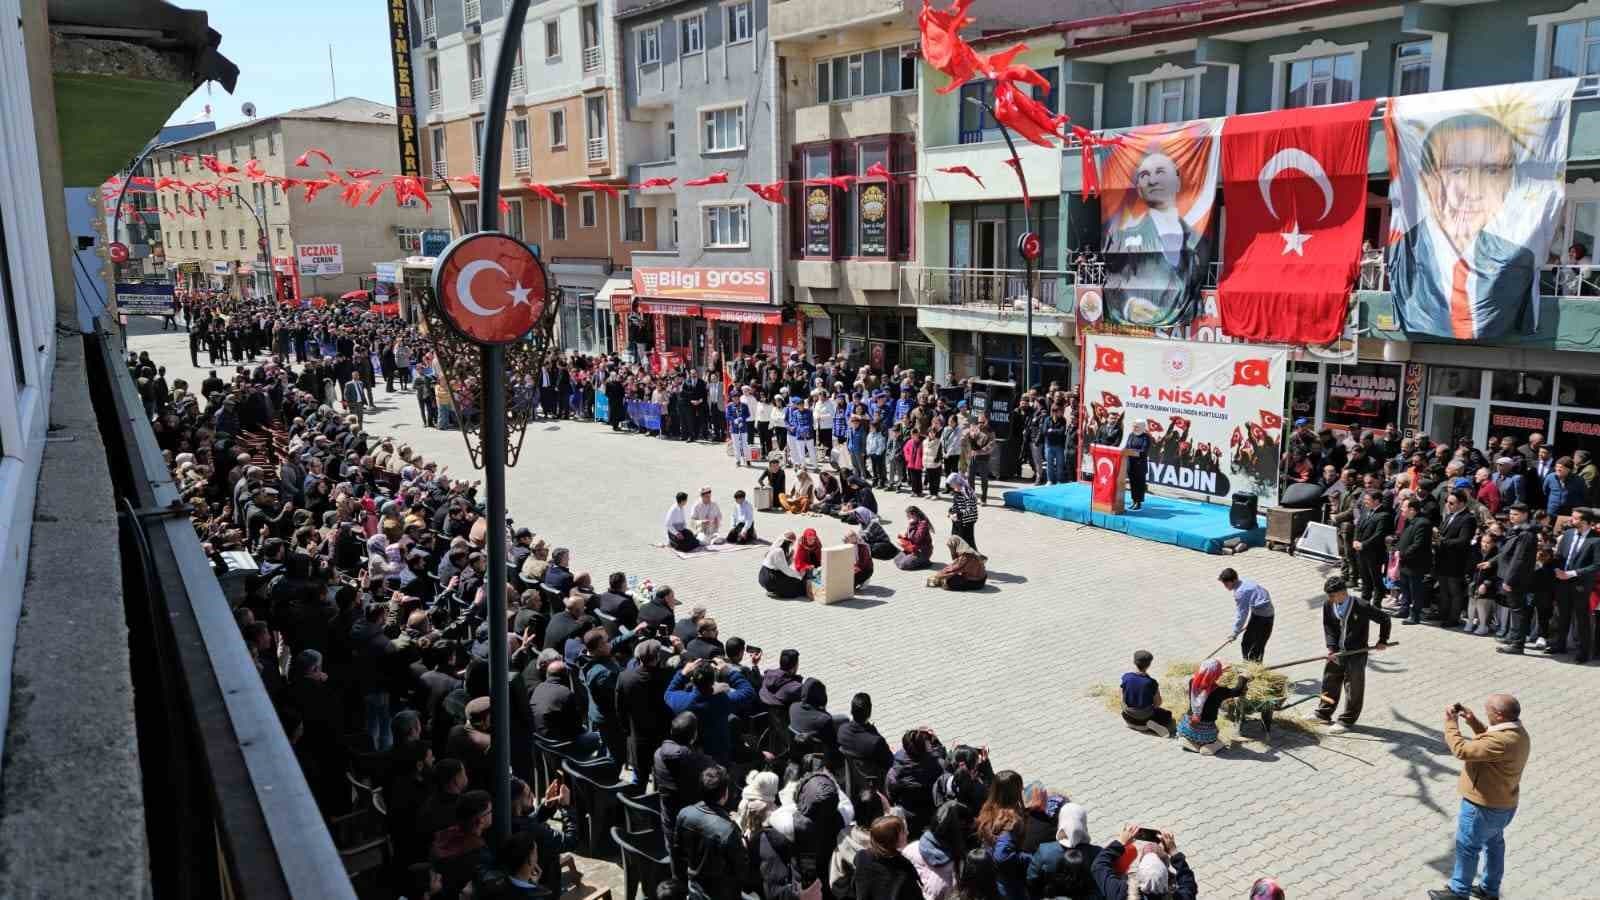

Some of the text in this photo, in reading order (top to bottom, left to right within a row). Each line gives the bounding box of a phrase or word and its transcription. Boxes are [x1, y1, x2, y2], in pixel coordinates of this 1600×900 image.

[301, 246, 337, 256] ECZANE
[707, 270, 765, 288] gross
[1130, 385, 1226, 408] 14 NİSAN
